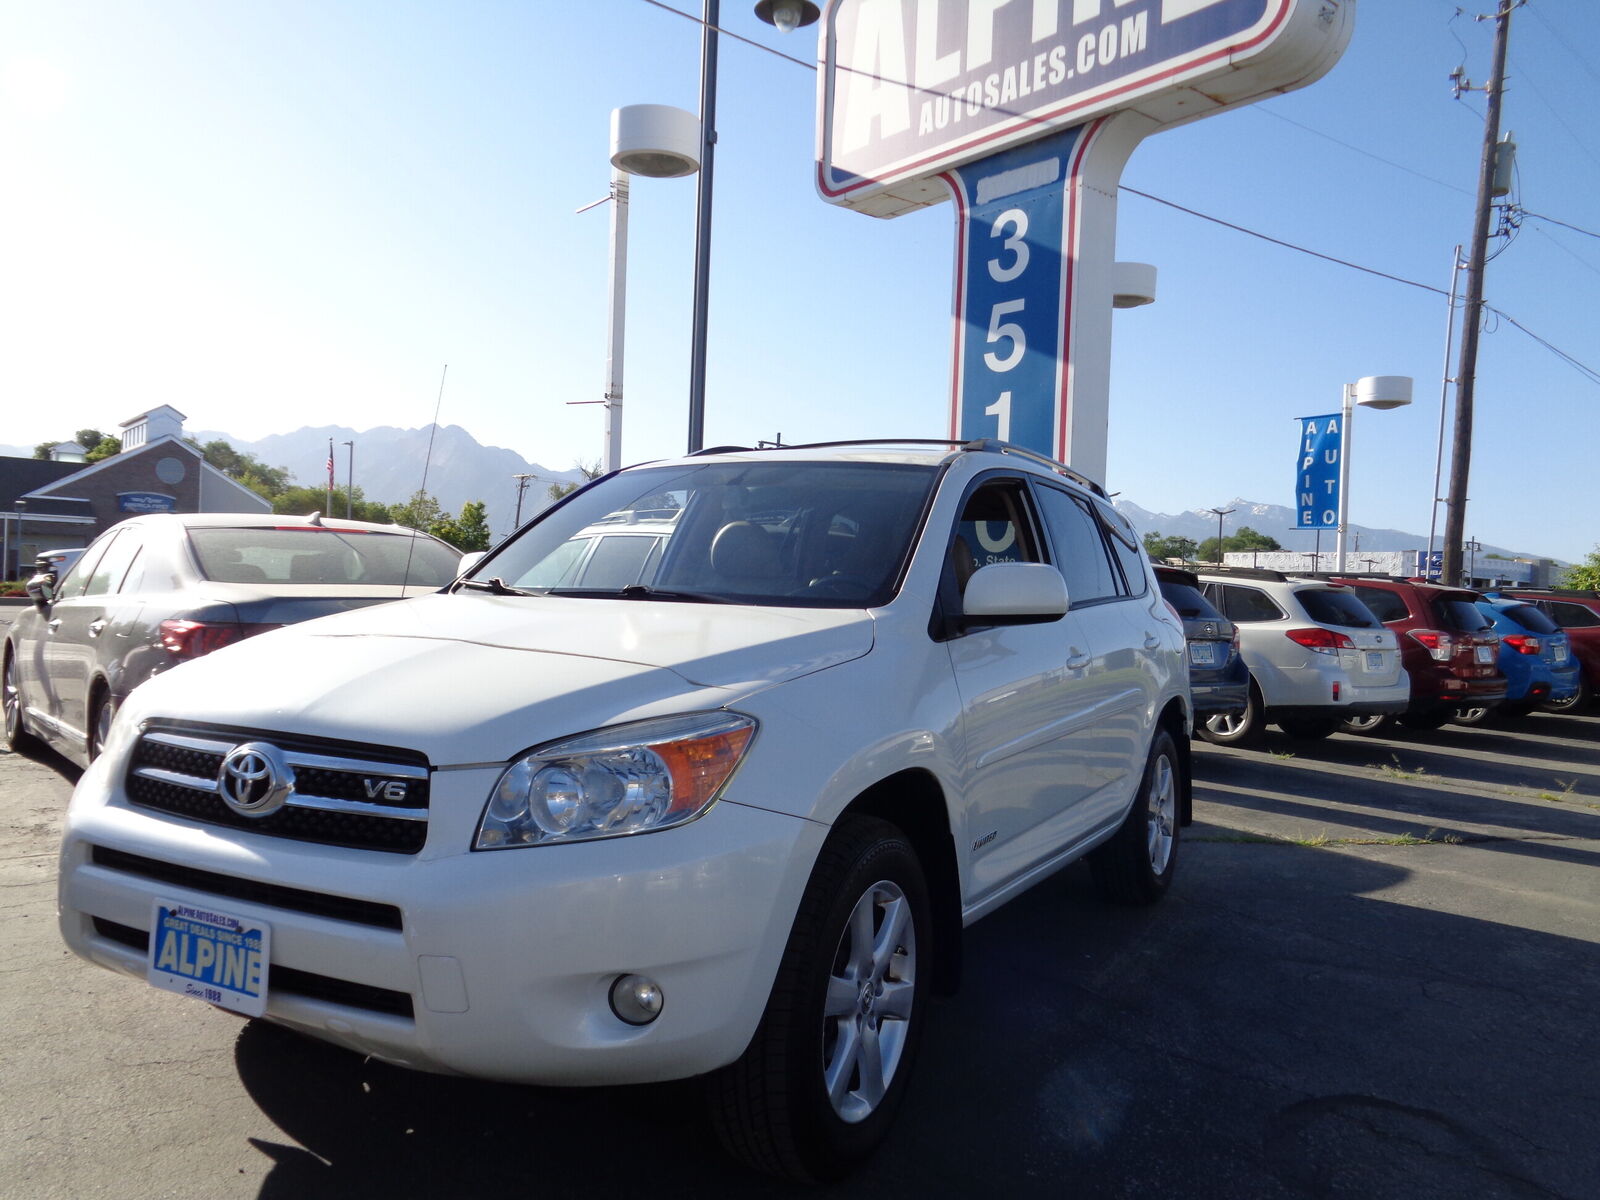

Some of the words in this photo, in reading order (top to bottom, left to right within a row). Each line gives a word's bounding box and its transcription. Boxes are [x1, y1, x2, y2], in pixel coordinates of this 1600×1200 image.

[919, 10, 1147, 136] AUTOSALES.COM
[1301, 421, 1317, 524] ALPINE
[1323, 419, 1338, 525] AUTO
[364, 779, 407, 800] V6
[157, 930, 261, 993] ALPINE
[185, 983, 204, 997] Since
